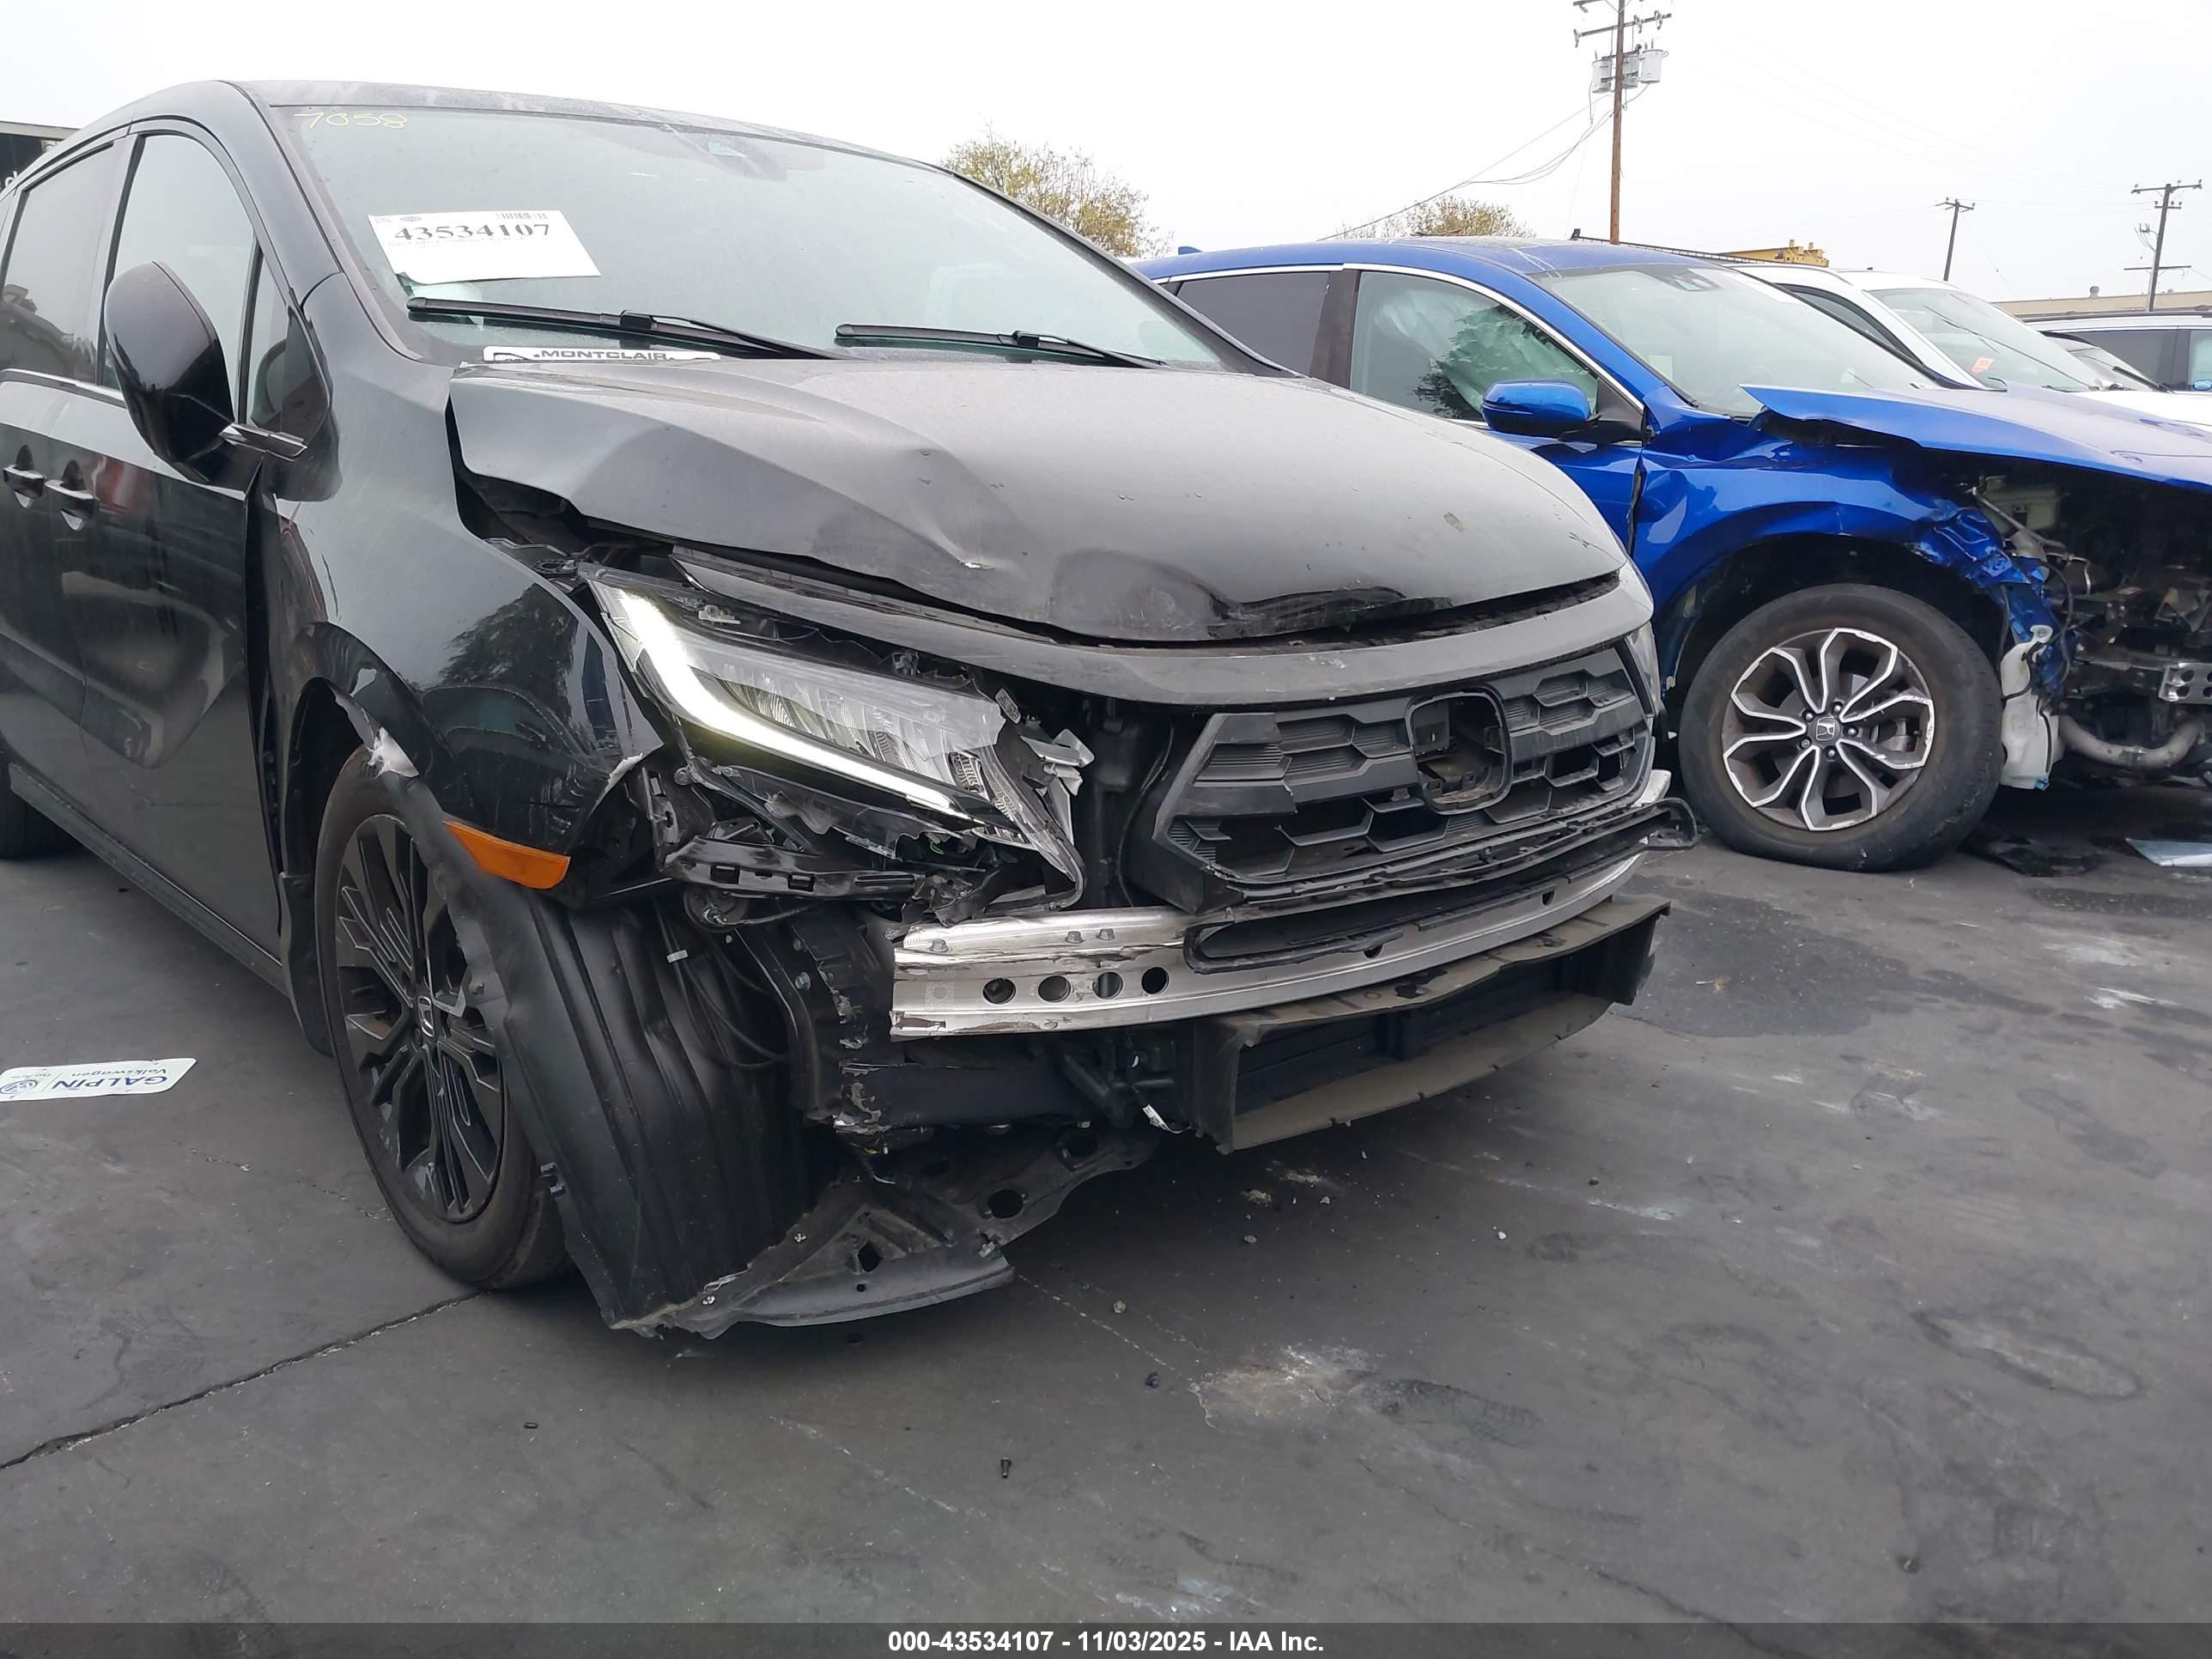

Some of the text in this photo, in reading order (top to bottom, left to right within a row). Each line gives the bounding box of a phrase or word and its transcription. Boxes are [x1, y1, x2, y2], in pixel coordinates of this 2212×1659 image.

[394, 223, 550, 240] 43534107
[540, 349, 667, 361] MONTCLAIR
[71, 1068, 167, 1077] Volkswagen
[52, 1075, 168, 1091] GALPIN
